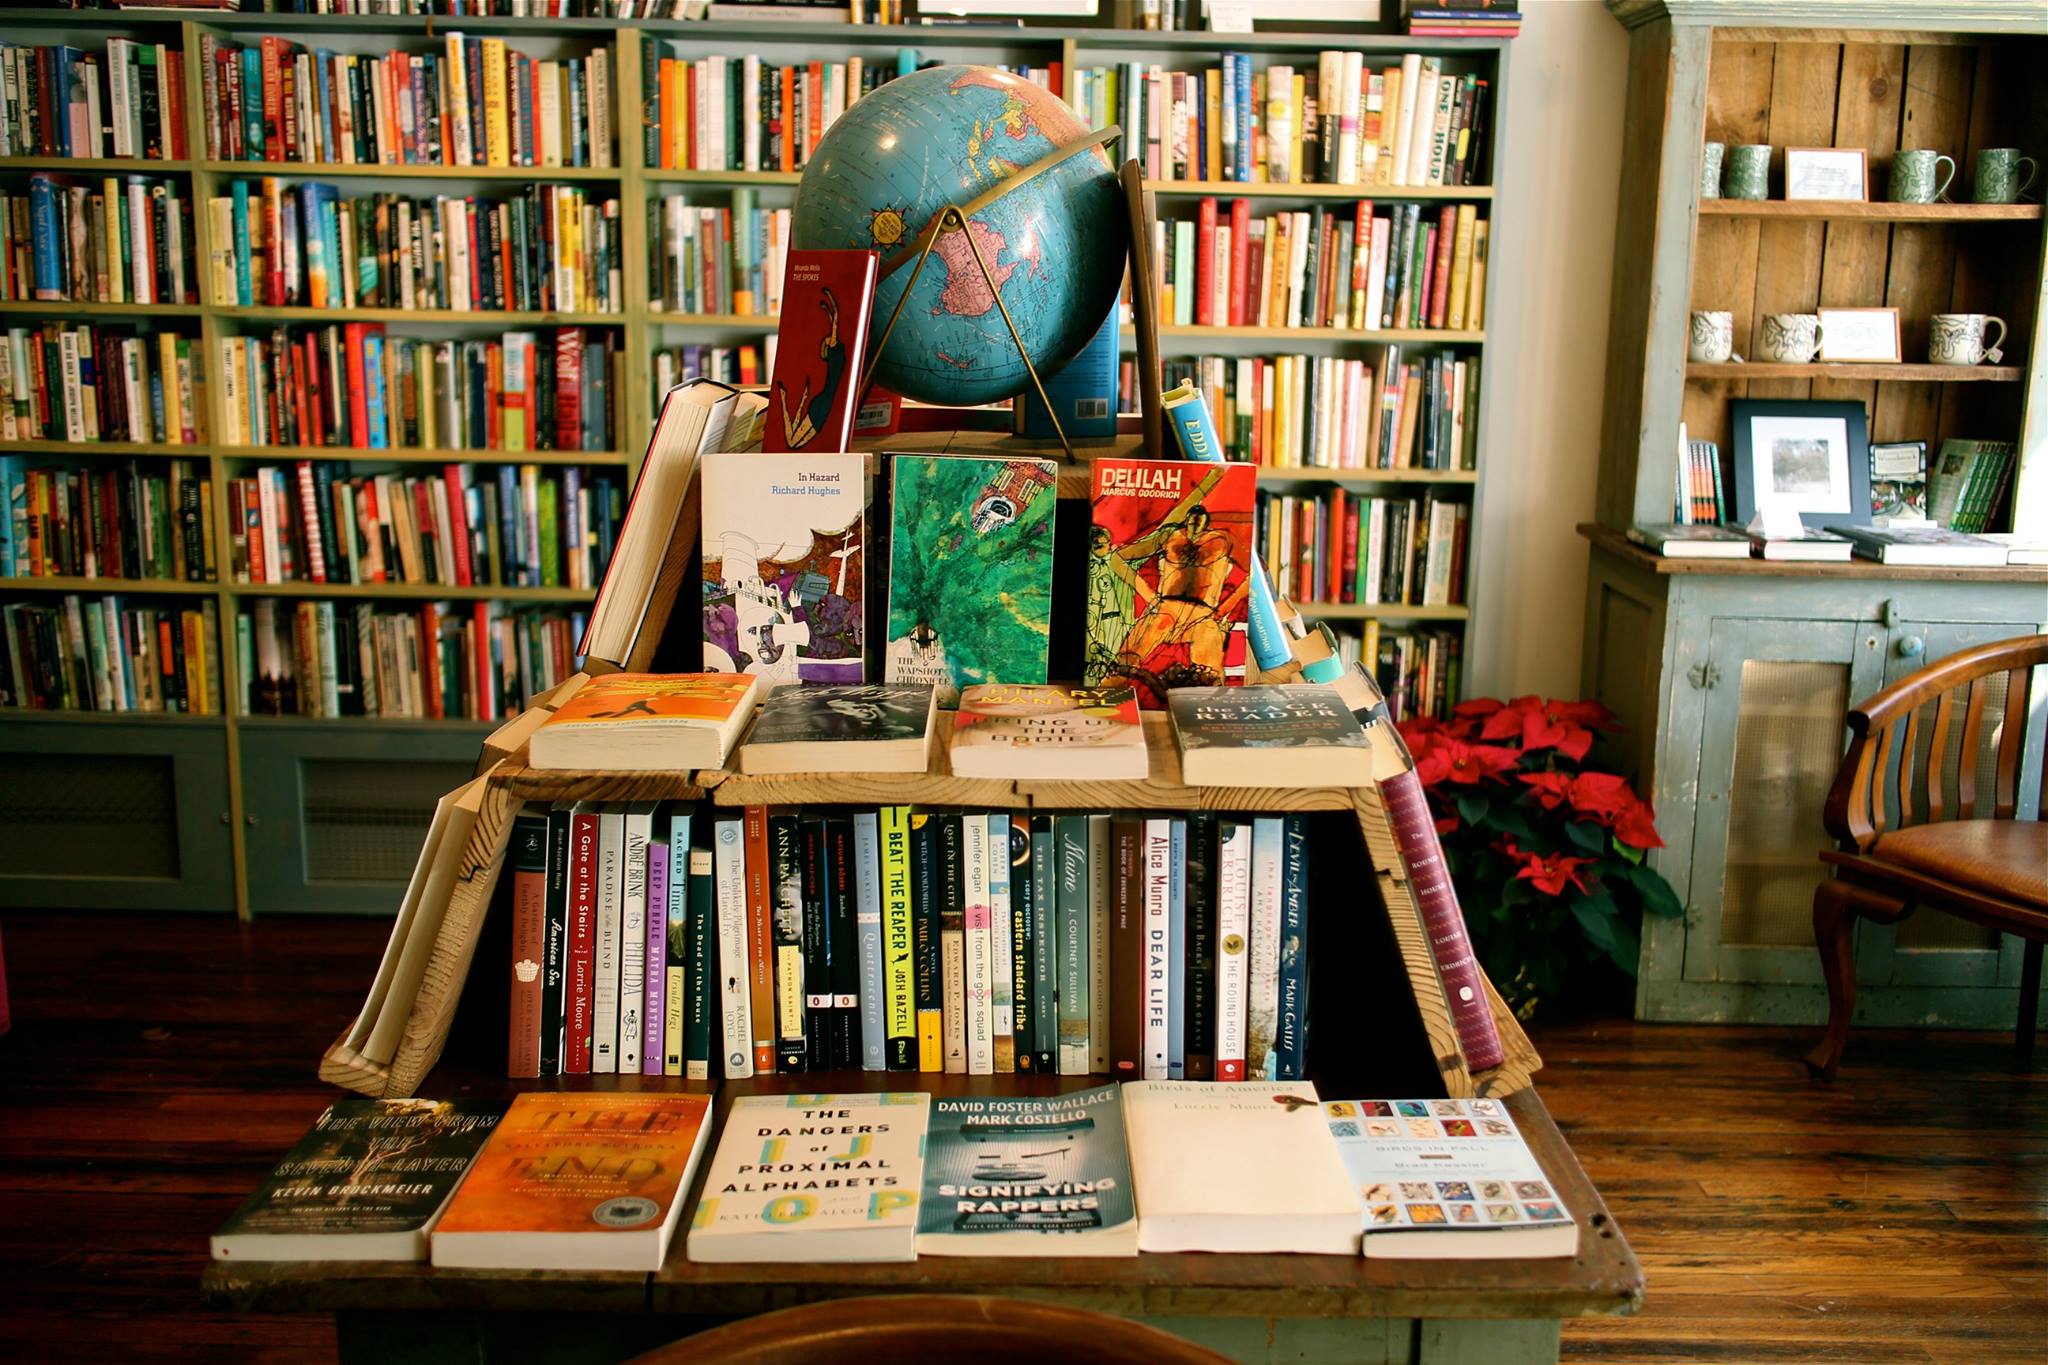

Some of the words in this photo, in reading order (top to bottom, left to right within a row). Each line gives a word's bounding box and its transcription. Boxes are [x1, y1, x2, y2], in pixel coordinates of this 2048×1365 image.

[229, 53, 238, 84] WARD
[231, 87, 240, 111] JUST
[1438, 80, 1451, 113] ONE
[1430, 132, 1444, 179] HOUR
[556, 331, 582, 380] Wolf
[1185, 420, 1214, 461] EDDI
[772, 486, 805, 494] Richard
[808, 486, 840, 496] Hughes
[799, 473, 807, 481] In
[809, 473, 840, 481] Hazard
[1102, 468, 1182, 490] DELILAH
[1101, 487, 1136, 496] MARCUS
[1138, 489, 1180, 499] GOODRICH
[897, 666, 945, 675] WAPSHOT
[980, 697, 1116, 706] MANTEL
[1194, 710, 1339, 720] READER
[581, 822, 591, 831] A
[945, 824, 955, 848] LOST
[580, 835, 591, 863] Gate
[629, 832, 645, 867] ANDRÉ
[778, 827, 789, 857] ANN
[889, 832, 903, 864] BEAT
[920, 841, 928, 864] WITCH
[947, 850, 956, 864] IN
[971, 824, 984, 864] jennifer
[1150, 836, 1168, 868] Alice
[1288, 832, 1304, 874] DEVIL
[579, 867, 589, 880] at
[731, 859, 740, 874] The
[1036, 846, 1044, 871] THE
[1063, 833, 1085, 893] Maine
[604, 850, 614, 911] PARADISE
[627, 868, 644, 898] BRINK
[653, 861, 662, 889] DEEP
[721, 880, 731, 889] of
[890, 870, 904, 897] THE
[947, 867, 955, 882] THE
[972, 867, 982, 893] egan
[1036, 877, 1044, 902] TAX
[1222, 848, 1235, 930] ERDRICH
[1234, 857, 1247, 921] LOUISE
[579, 883, 589, 900] the
[671, 879, 686, 914] Time
[722, 891, 732, 921] Harold
[729, 876, 742, 913] Unlikely
[779, 863, 793, 934] PATCHETT
[921, 871, 930, 914] PORTOBELLO
[947, 885, 956, 907] CITY
[1150, 875, 1168, 916] Munro
[1287, 880, 1303, 928] AMBER
[578, 905, 588, 938] Stairs
[651, 897, 660, 940] PURPLE
[891, 901, 906, 949] REAPER
[974, 913, 984, 933] visit
[1068, 908, 1077, 916] J.
[549, 918, 563, 966] American
[720, 924, 733, 937] Fry
[730, 915, 743, 959] Pilgrimage
[918, 918, 929, 953] PAULO
[1014, 910, 1026, 952] eastern
[1038, 907, 1047, 982] INSPECTOR
[1068, 919, 1078, 968] COURTNEY
[603, 930, 612, 970] BLIND
[975, 937, 984, 959] from
[1151, 930, 1163, 980] DEAR
[548, 969, 560, 986] Son
[576, 960, 587, 993] Lorrie
[623, 941, 643, 996] PHILIDA
[696, 962, 703, 971] of
[863, 932, 878, 1024] Quattrocento
[919, 956, 930, 1001] COELHO
[952, 940, 960, 987] EDWARD
[976, 962, 985, 979] the
[1015, 955, 1026, 1001] standard
[1227, 960, 1238, 979] THE
[671, 974, 680, 1006] Ursula
[695, 976, 703, 992] the
[895, 969, 906, 991] JOSH
[974, 982, 983, 1008] goon
[1069, 971, 1078, 1013] SULLIVAN
[1286, 978, 1297, 1010] MARK
[953, 991, 961, 1001] P.
[1151, 989, 1163, 1027] LIFE
[1226, 983, 1237, 1018] ROUND
[575, 996, 586, 1029] Moore
[648, 991, 658, 1043] MONTERO
[670, 1008, 679, 1030] Hegi
[725, 1011, 736, 1039] JOYCE
[736, 1005, 746, 1044] RACHEL
[896, 994, 908, 1032] BAZELL
[953, 1005, 962, 1041] JONES
[974, 1011, 985, 1041] squad
[1016, 1004, 1026, 1031] tribe
[1225, 1021, 1236, 1054] HOUSE
[1283, 1012, 1296, 1051] GATISS
[938, 1102, 985, 1113] DAVID
[989, 1102, 1042, 1113] FOSTER
[1047, 1089, 1114, 1111] WALLACE
[1200, 1084, 1215, 1092] of
[802, 1109, 851, 1119] THE
[967, 1114, 1011, 1125] MARK
[1015, 1110, 1086, 1125] COSTELLO
[757, 1124, 890, 1137] DANGERS
[810, 1145, 829, 1153] of
[391, 1157, 467, 1172] LAYER
[738, 1159, 891, 1174] PROXIMAL
[272, 1187, 322, 1198] KEVIN
[328, 1183, 433, 1195] BROCKMEIER
[722, 1176, 898, 1193] ALPHABETS
[938, 1178, 1116, 1198] SIGNIFYING
[957, 1197, 1099, 1213] RAPPERS
